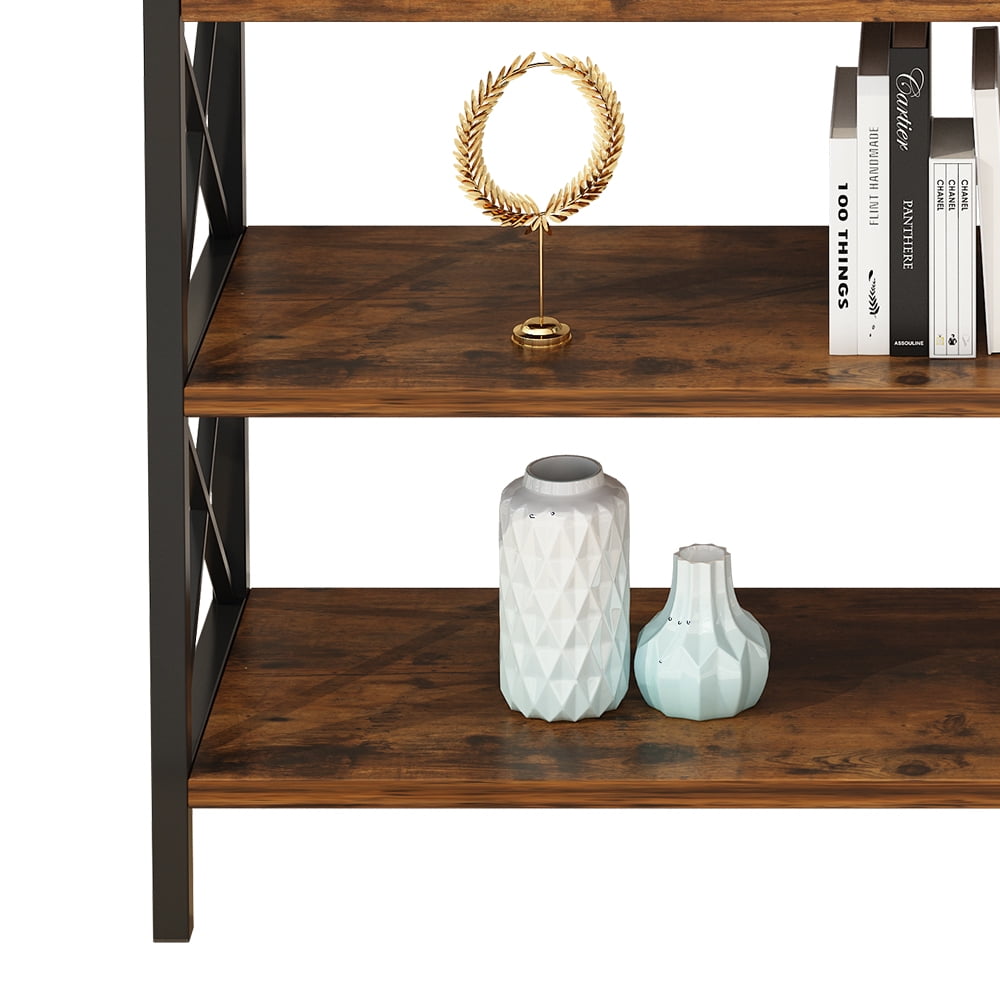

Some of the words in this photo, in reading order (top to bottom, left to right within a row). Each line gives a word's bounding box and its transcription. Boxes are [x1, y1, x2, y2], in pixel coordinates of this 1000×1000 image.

[895, 67, 925, 151] Cartier
[868, 126, 880, 190] HANDMADE
[837, 182, 849, 222] 100
[868, 195, 880, 226] FLINT
[936, 178, 945, 212] CHANEL
[948, 178, 957, 212] CHANEL
[960, 178, 969, 212] CHANEL
[902, 199, 914, 270] PANTHERE
[837, 228, 849, 310] THINGS
